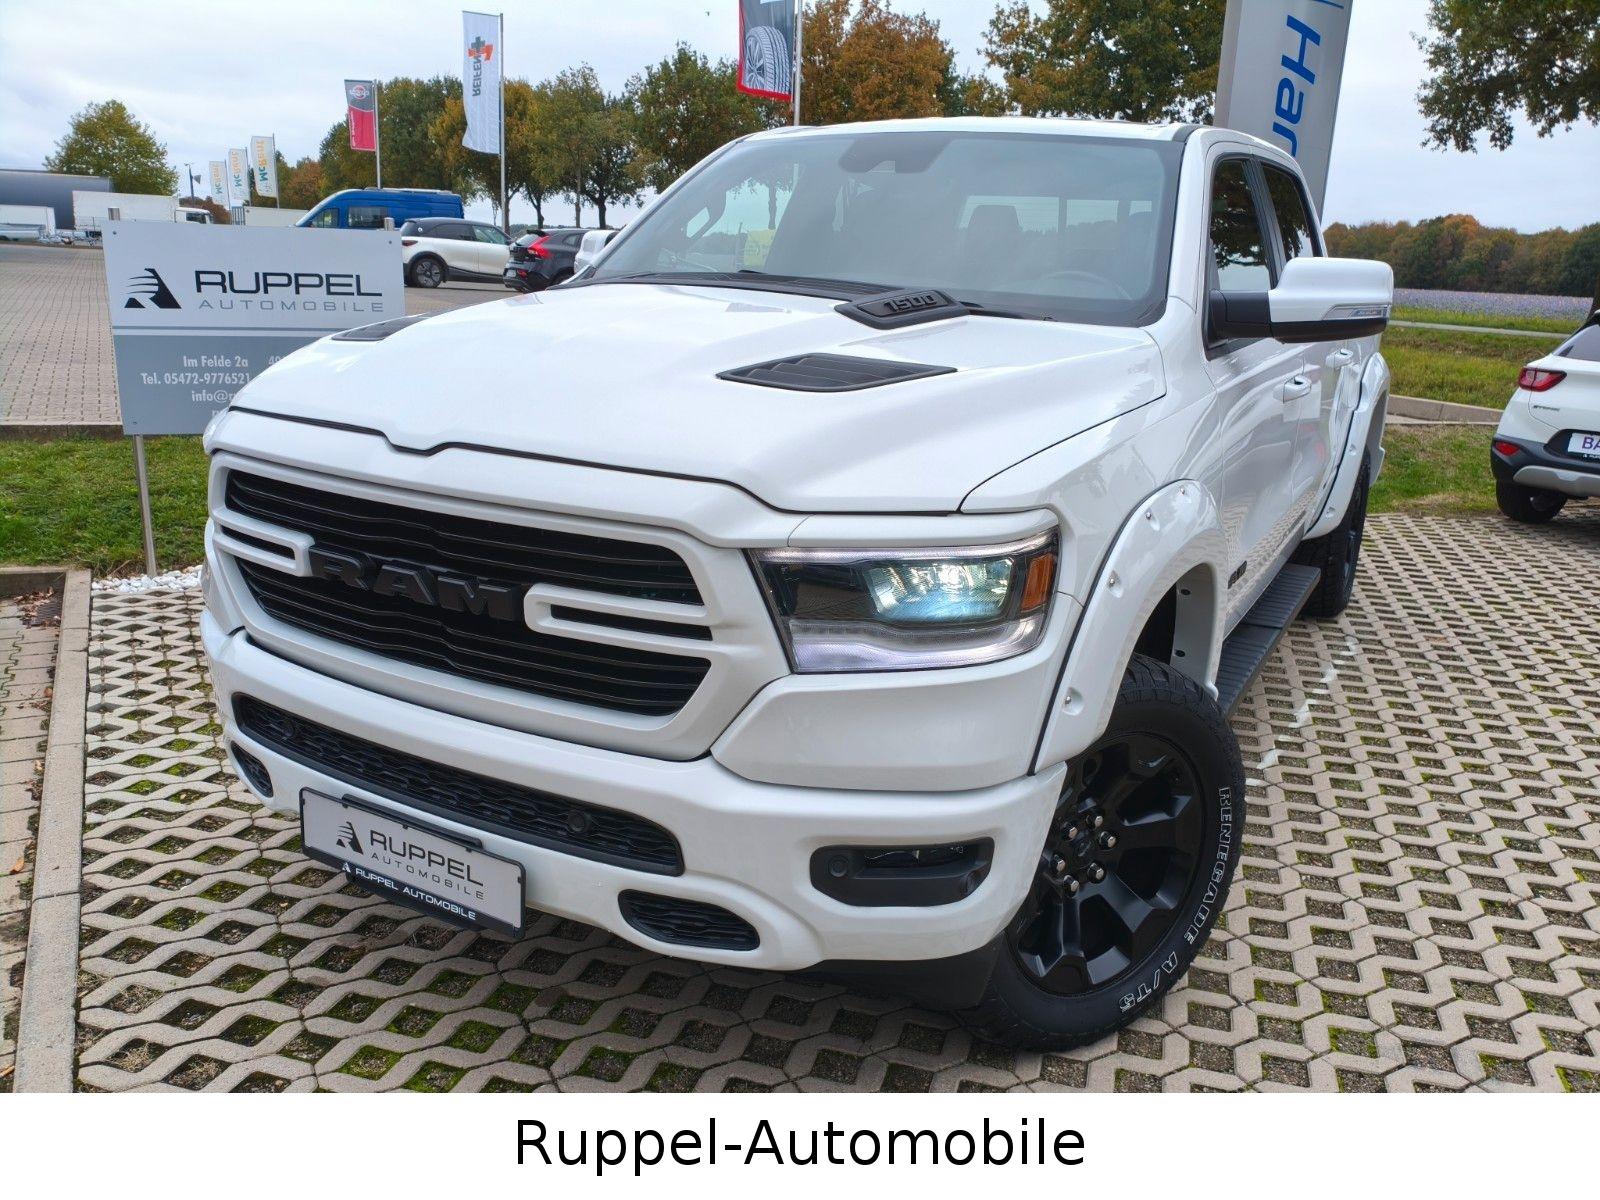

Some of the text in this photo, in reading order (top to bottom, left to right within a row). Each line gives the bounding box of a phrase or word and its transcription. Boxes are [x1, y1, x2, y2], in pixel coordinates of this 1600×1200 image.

[194, 270, 382, 297] RUPPEL
[198, 300, 384, 313] AUTOMOBILE
[883, 295, 937, 313] 1500
[141, 372, 251, 385] Tel. 05472-9776521
[183, 356, 198, 367] Im
[201, 355, 232, 368] Felde
[236, 355, 248, 367] 2a
[309, 547, 520, 621] RAM
[370, 829, 484, 887] RUPPEL
[371, 852, 485, 900] AUTOMOBILE
[1184, 787, 1232, 945] RENEGADE
[355, 867, 477, 921] RUPPEL AUTOMOBILE
